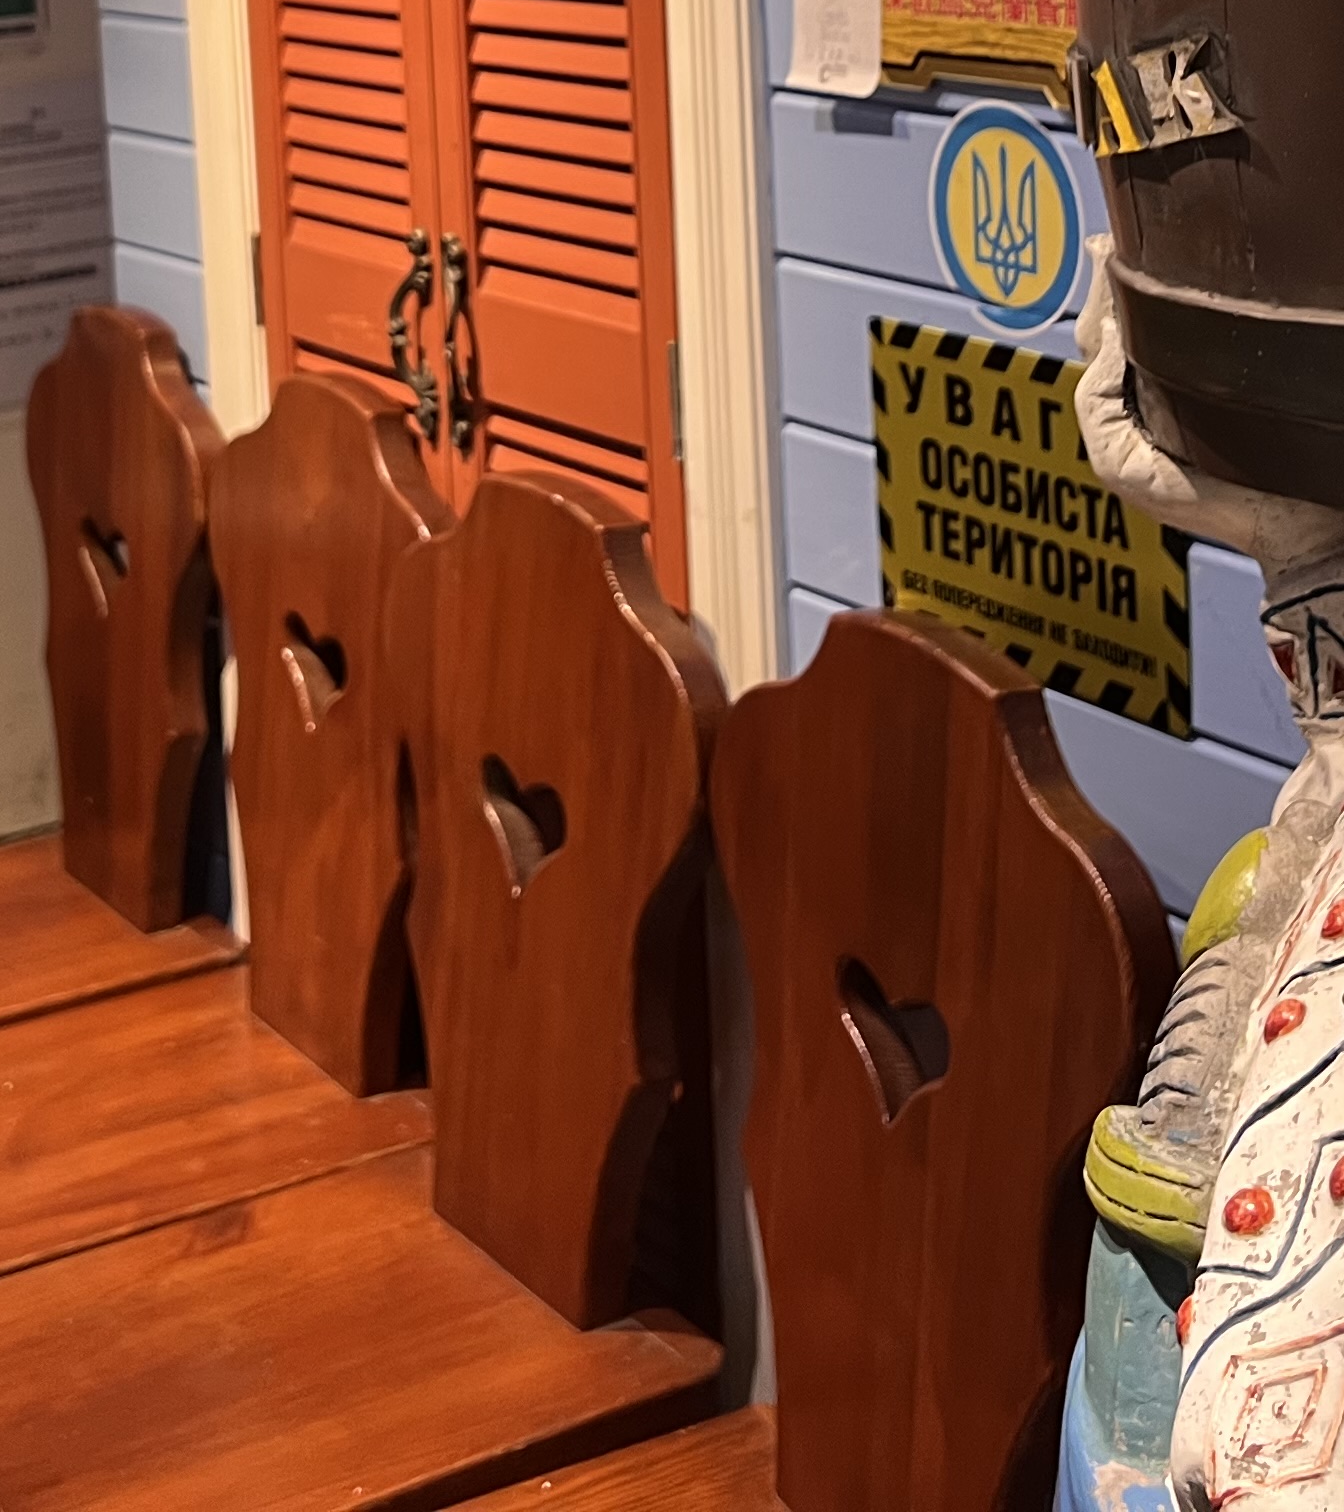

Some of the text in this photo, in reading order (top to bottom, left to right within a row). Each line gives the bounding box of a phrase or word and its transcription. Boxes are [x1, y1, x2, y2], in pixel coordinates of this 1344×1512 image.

[898, 361, 1089, 462] УВАГ
[919, 437, 1130, 551] ОСОБИСТА
[915, 500, 1138, 623] ТЕРИТОРІЯ
